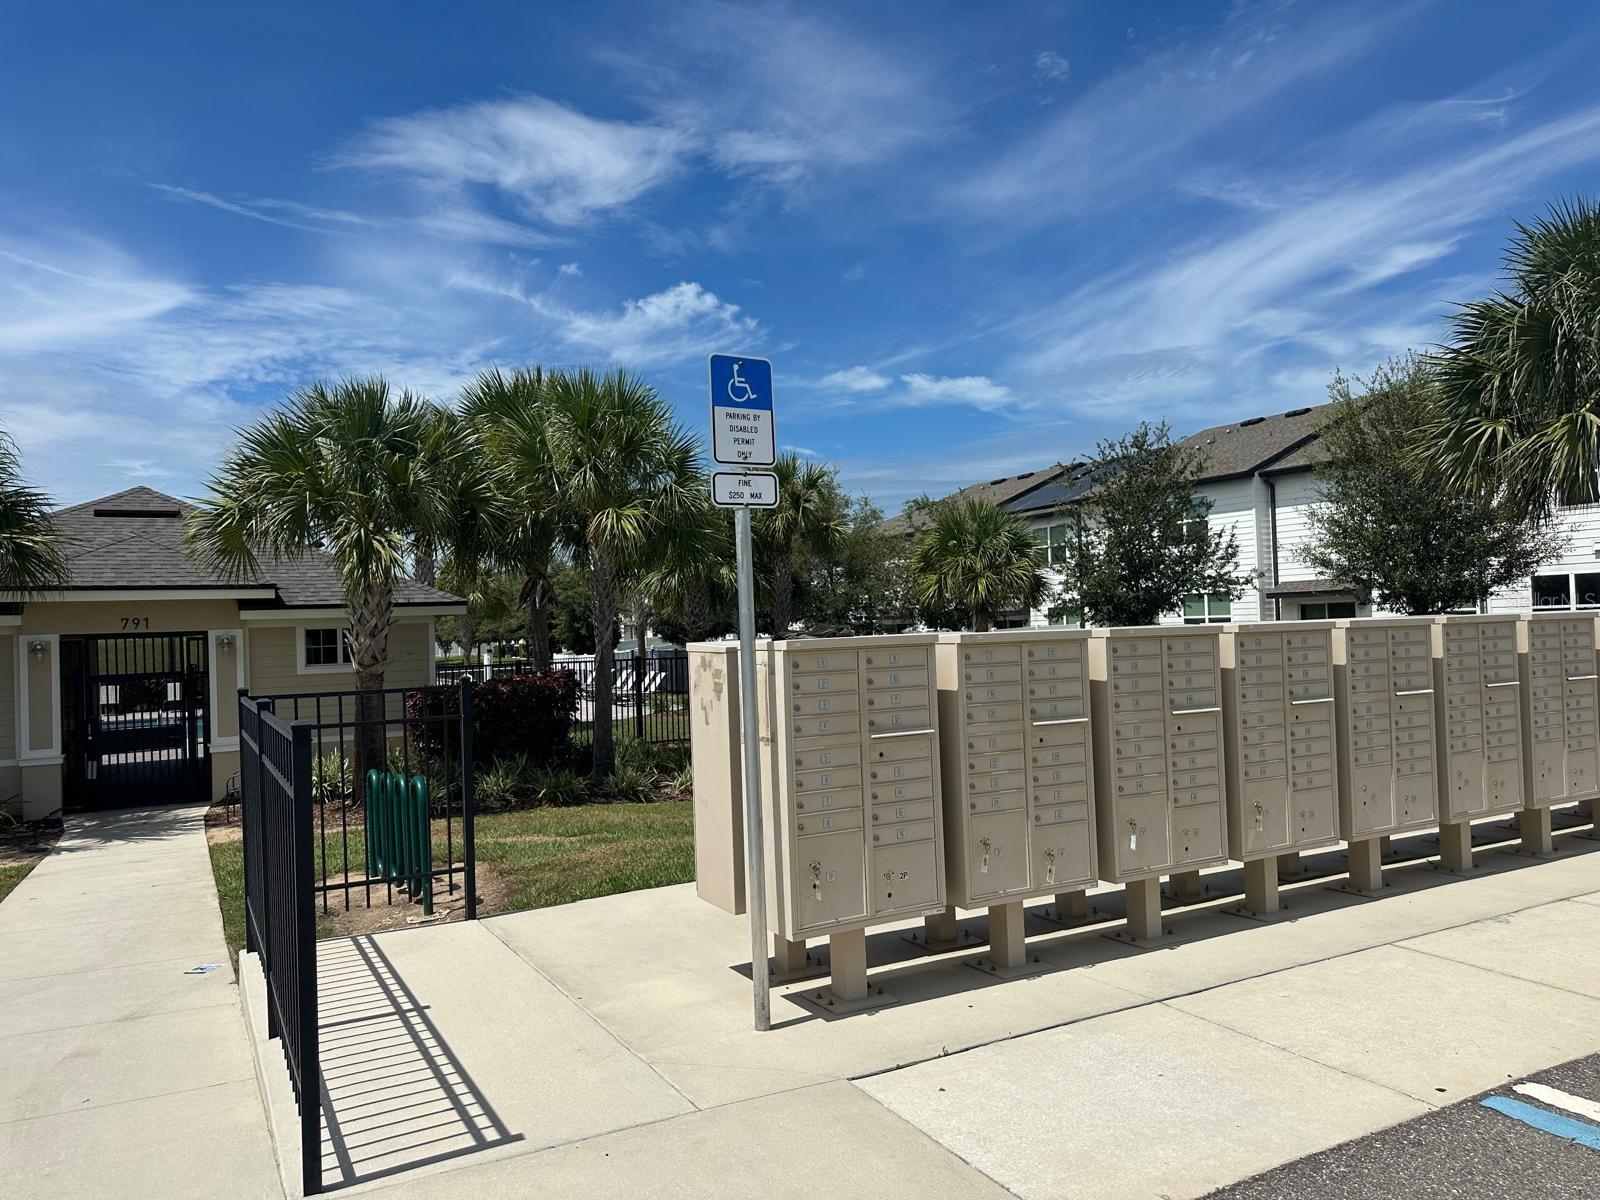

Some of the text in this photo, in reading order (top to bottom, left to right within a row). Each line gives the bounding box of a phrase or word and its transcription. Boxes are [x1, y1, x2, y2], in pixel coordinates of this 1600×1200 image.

[725, 411, 761, 422] PARKING BY
[729, 424, 759, 434] DISABLED
[733, 437, 755, 446] PERMIT
[737, 450, 753, 459] ONLY
[738, 479, 752, 488] FINE
[728, 490, 763, 500] $250 MAX
[120, 616, 149, 630] 791
[899, 871, 909, 880] 2P
